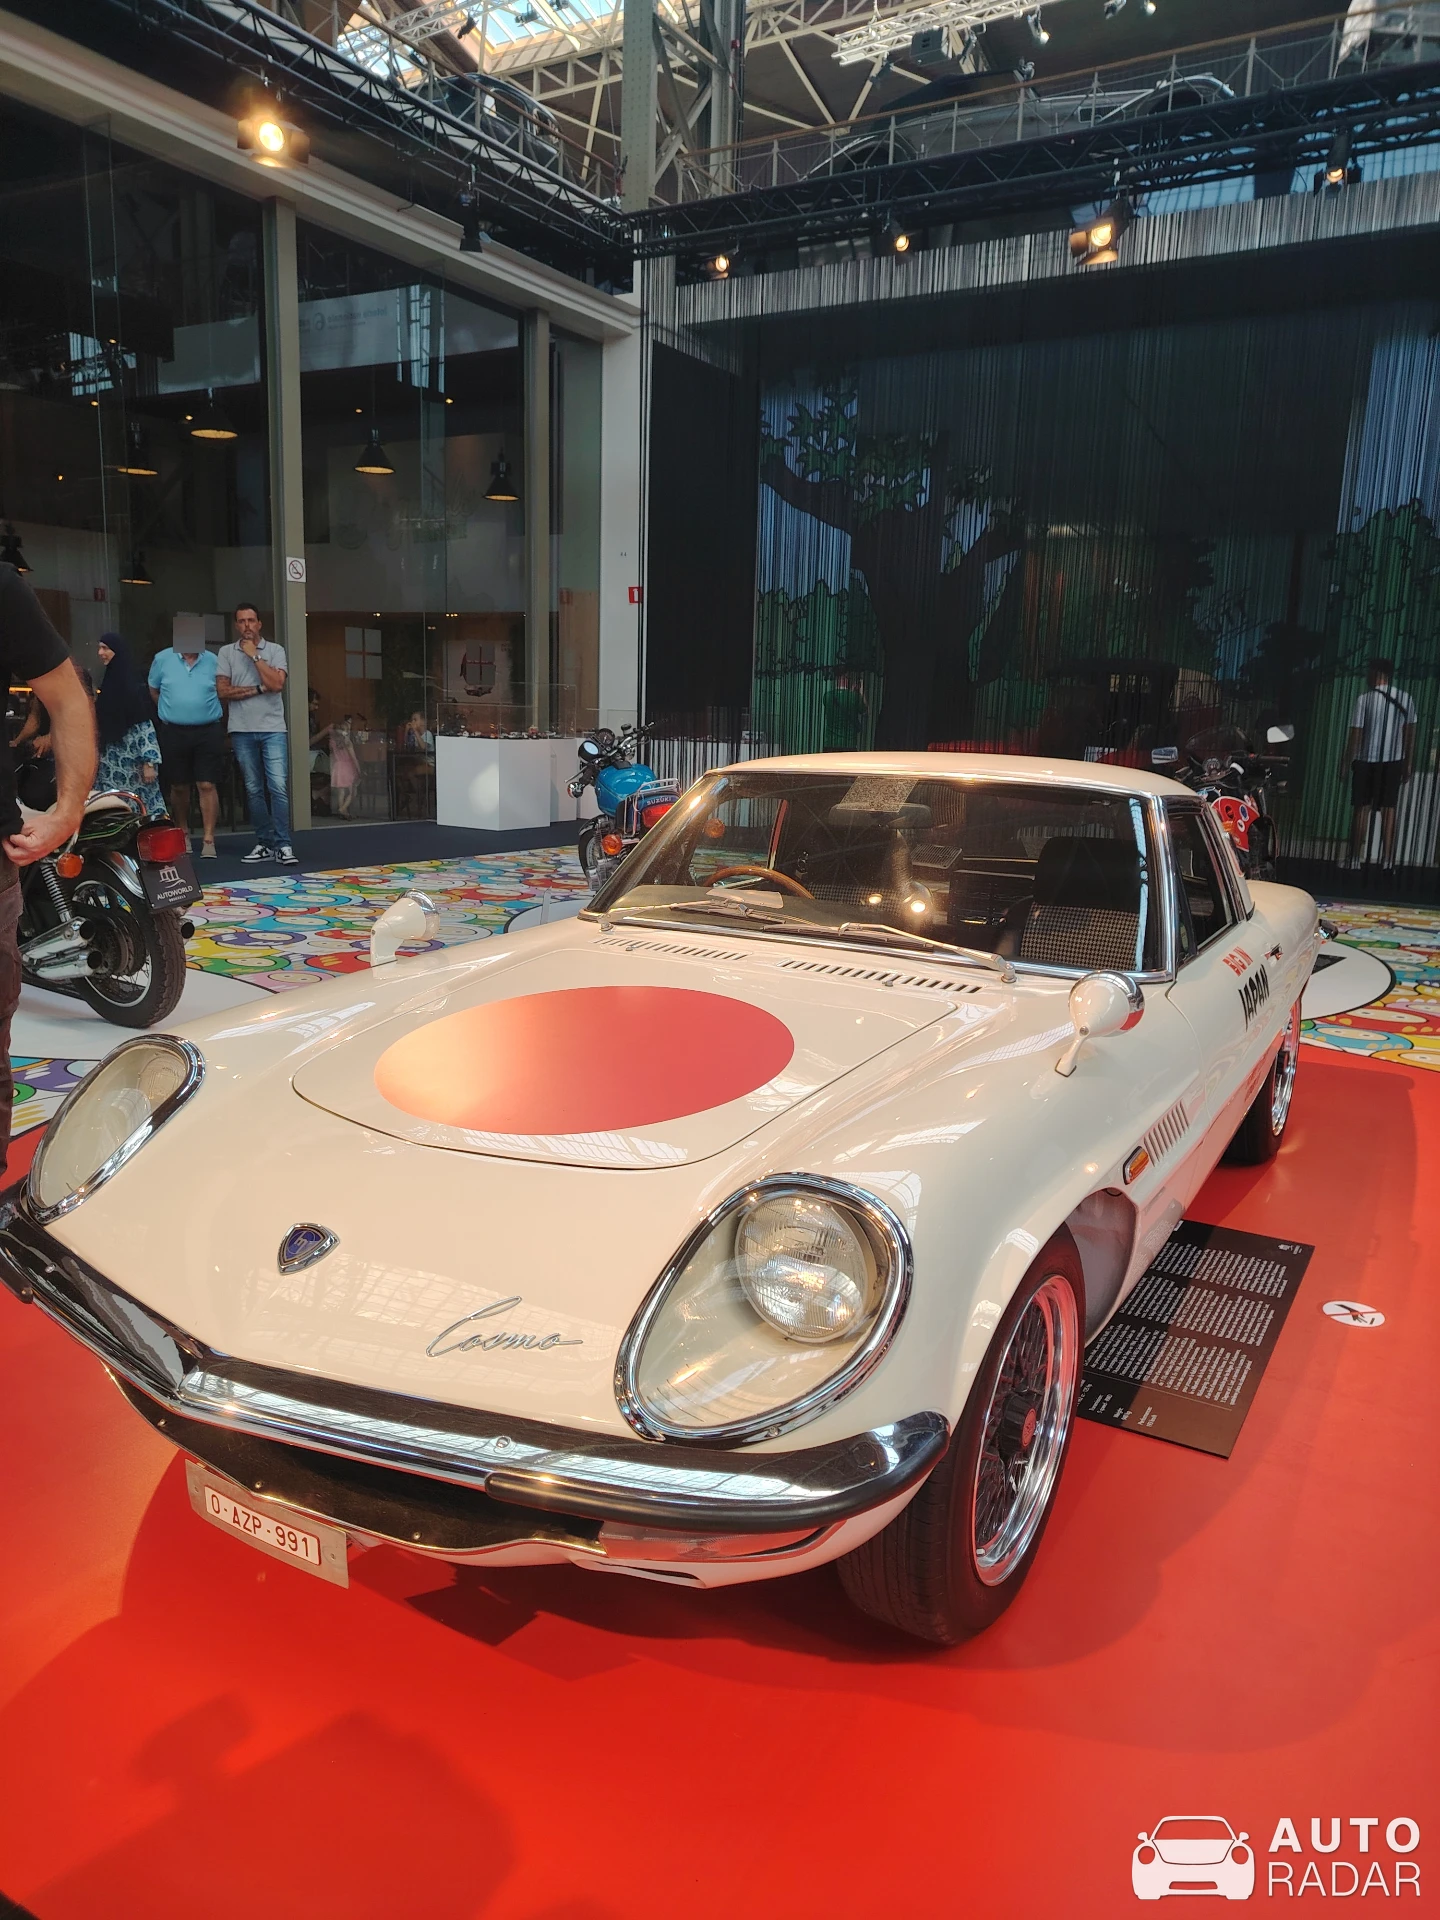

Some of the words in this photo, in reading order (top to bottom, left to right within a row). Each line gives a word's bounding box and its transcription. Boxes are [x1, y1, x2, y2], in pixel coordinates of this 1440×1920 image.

[646, 796, 672, 805] SUZUKI
[157, 885, 193, 900] AUTOWORLD
[1222, 953, 1247, 977] BIG
[1238, 964, 1270, 1033] JAPAN
[425, 1295, 583, 1357] Cosmo
